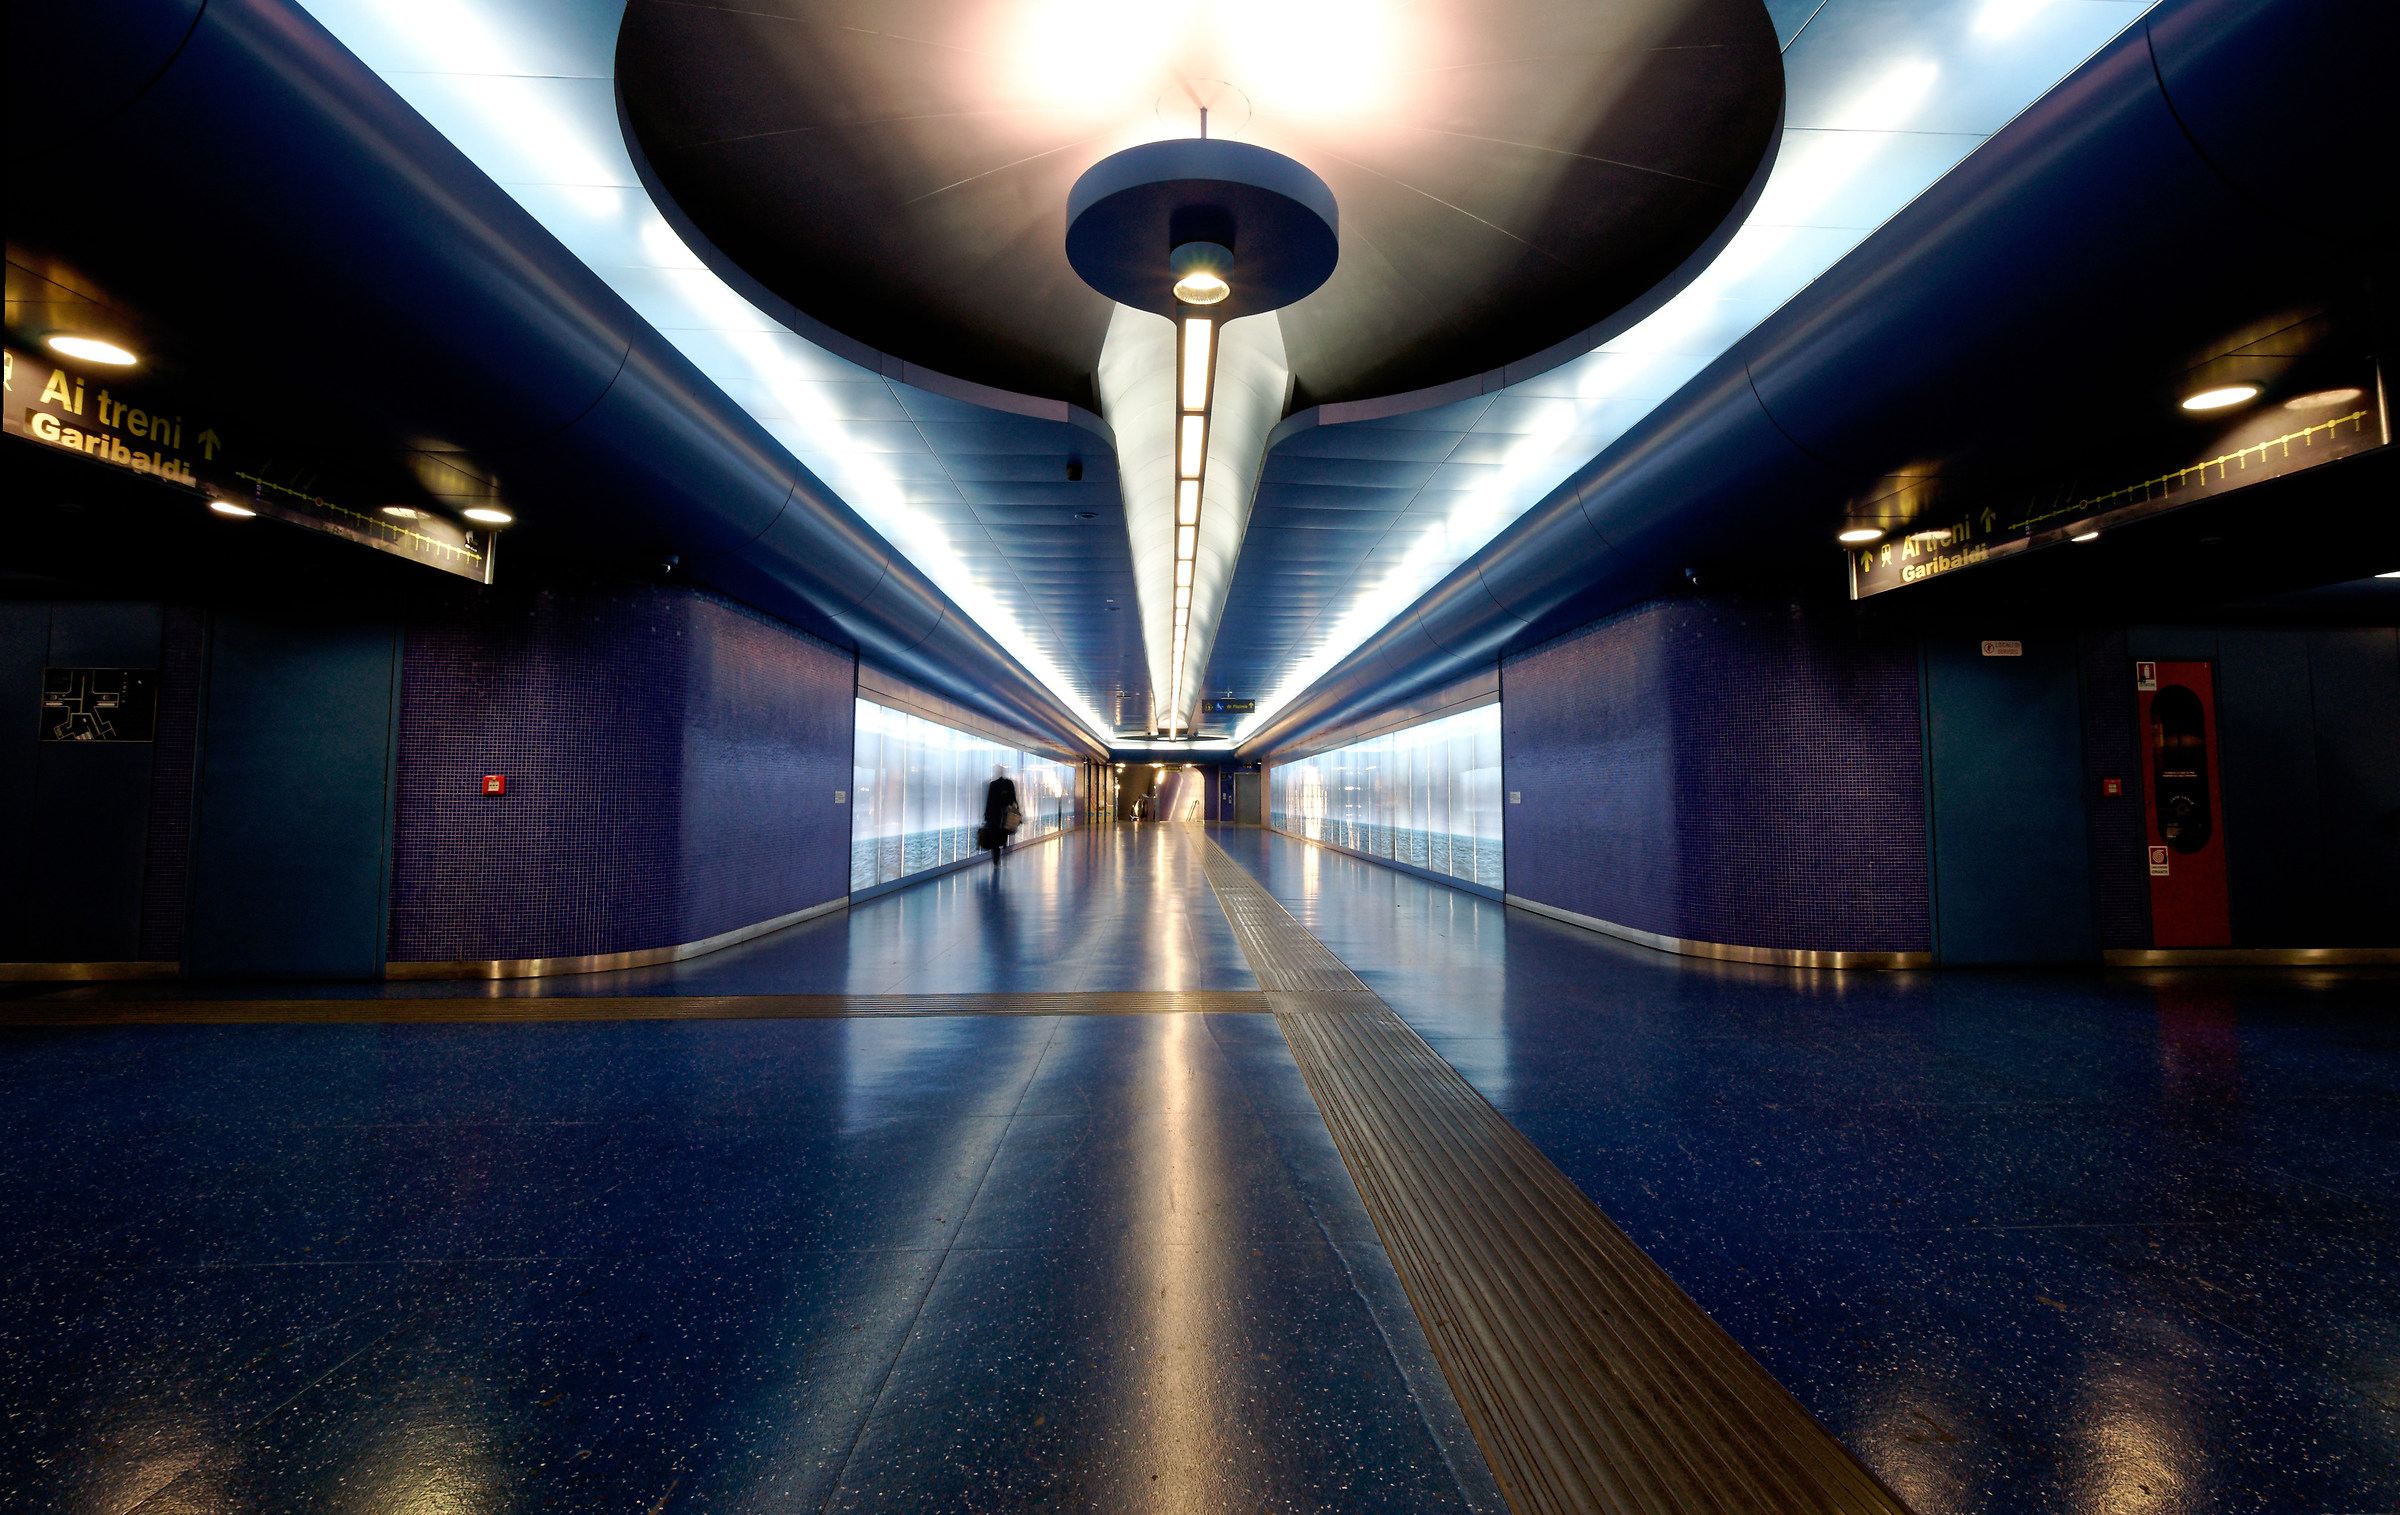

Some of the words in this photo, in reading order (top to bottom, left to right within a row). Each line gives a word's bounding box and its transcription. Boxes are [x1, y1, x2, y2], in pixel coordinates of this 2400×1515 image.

[40, 369, 85, 415] Ai
[97, 388, 182, 449] treni
[31, 412, 194, 485] Garibaldi
[1902, 542, 1988, 582] Garibaldi
